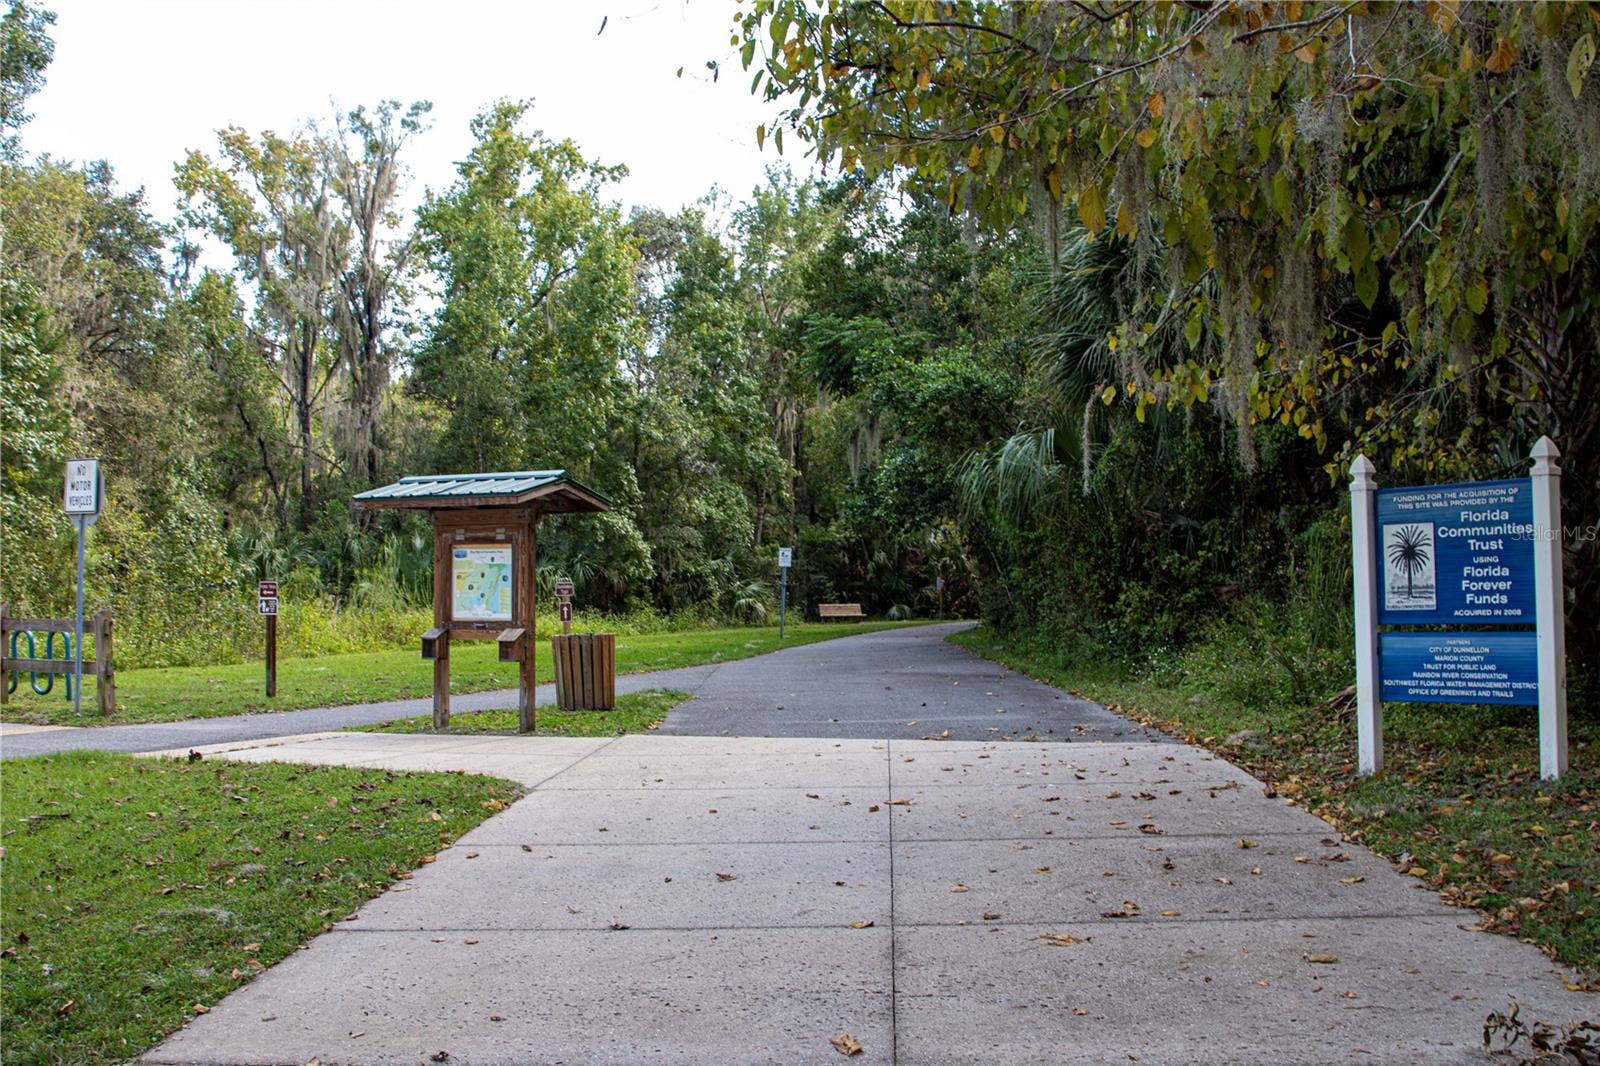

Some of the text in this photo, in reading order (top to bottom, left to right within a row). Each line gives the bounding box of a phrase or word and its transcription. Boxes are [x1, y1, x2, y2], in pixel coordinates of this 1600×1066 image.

[77, 464, 86, 476] NO
[71, 480, 91, 491] MOTOR
[70, 495, 92, 506] VEHICLES
[1393, 494, 1425, 502] FUNDING
[1459, 489, 1507, 498] ACQUISITION
[1460, 509, 1509, 522] Florida
[1438, 522, 1533, 538] Communities
[1468, 539, 1504, 550] Trust
[1463, 566, 1509, 577] Florida
[1461, 580, 1512, 591] Forever
[1466, 593, 1508, 604] Funds
[1468, 681, 1510, 689] MANAGEMENT
